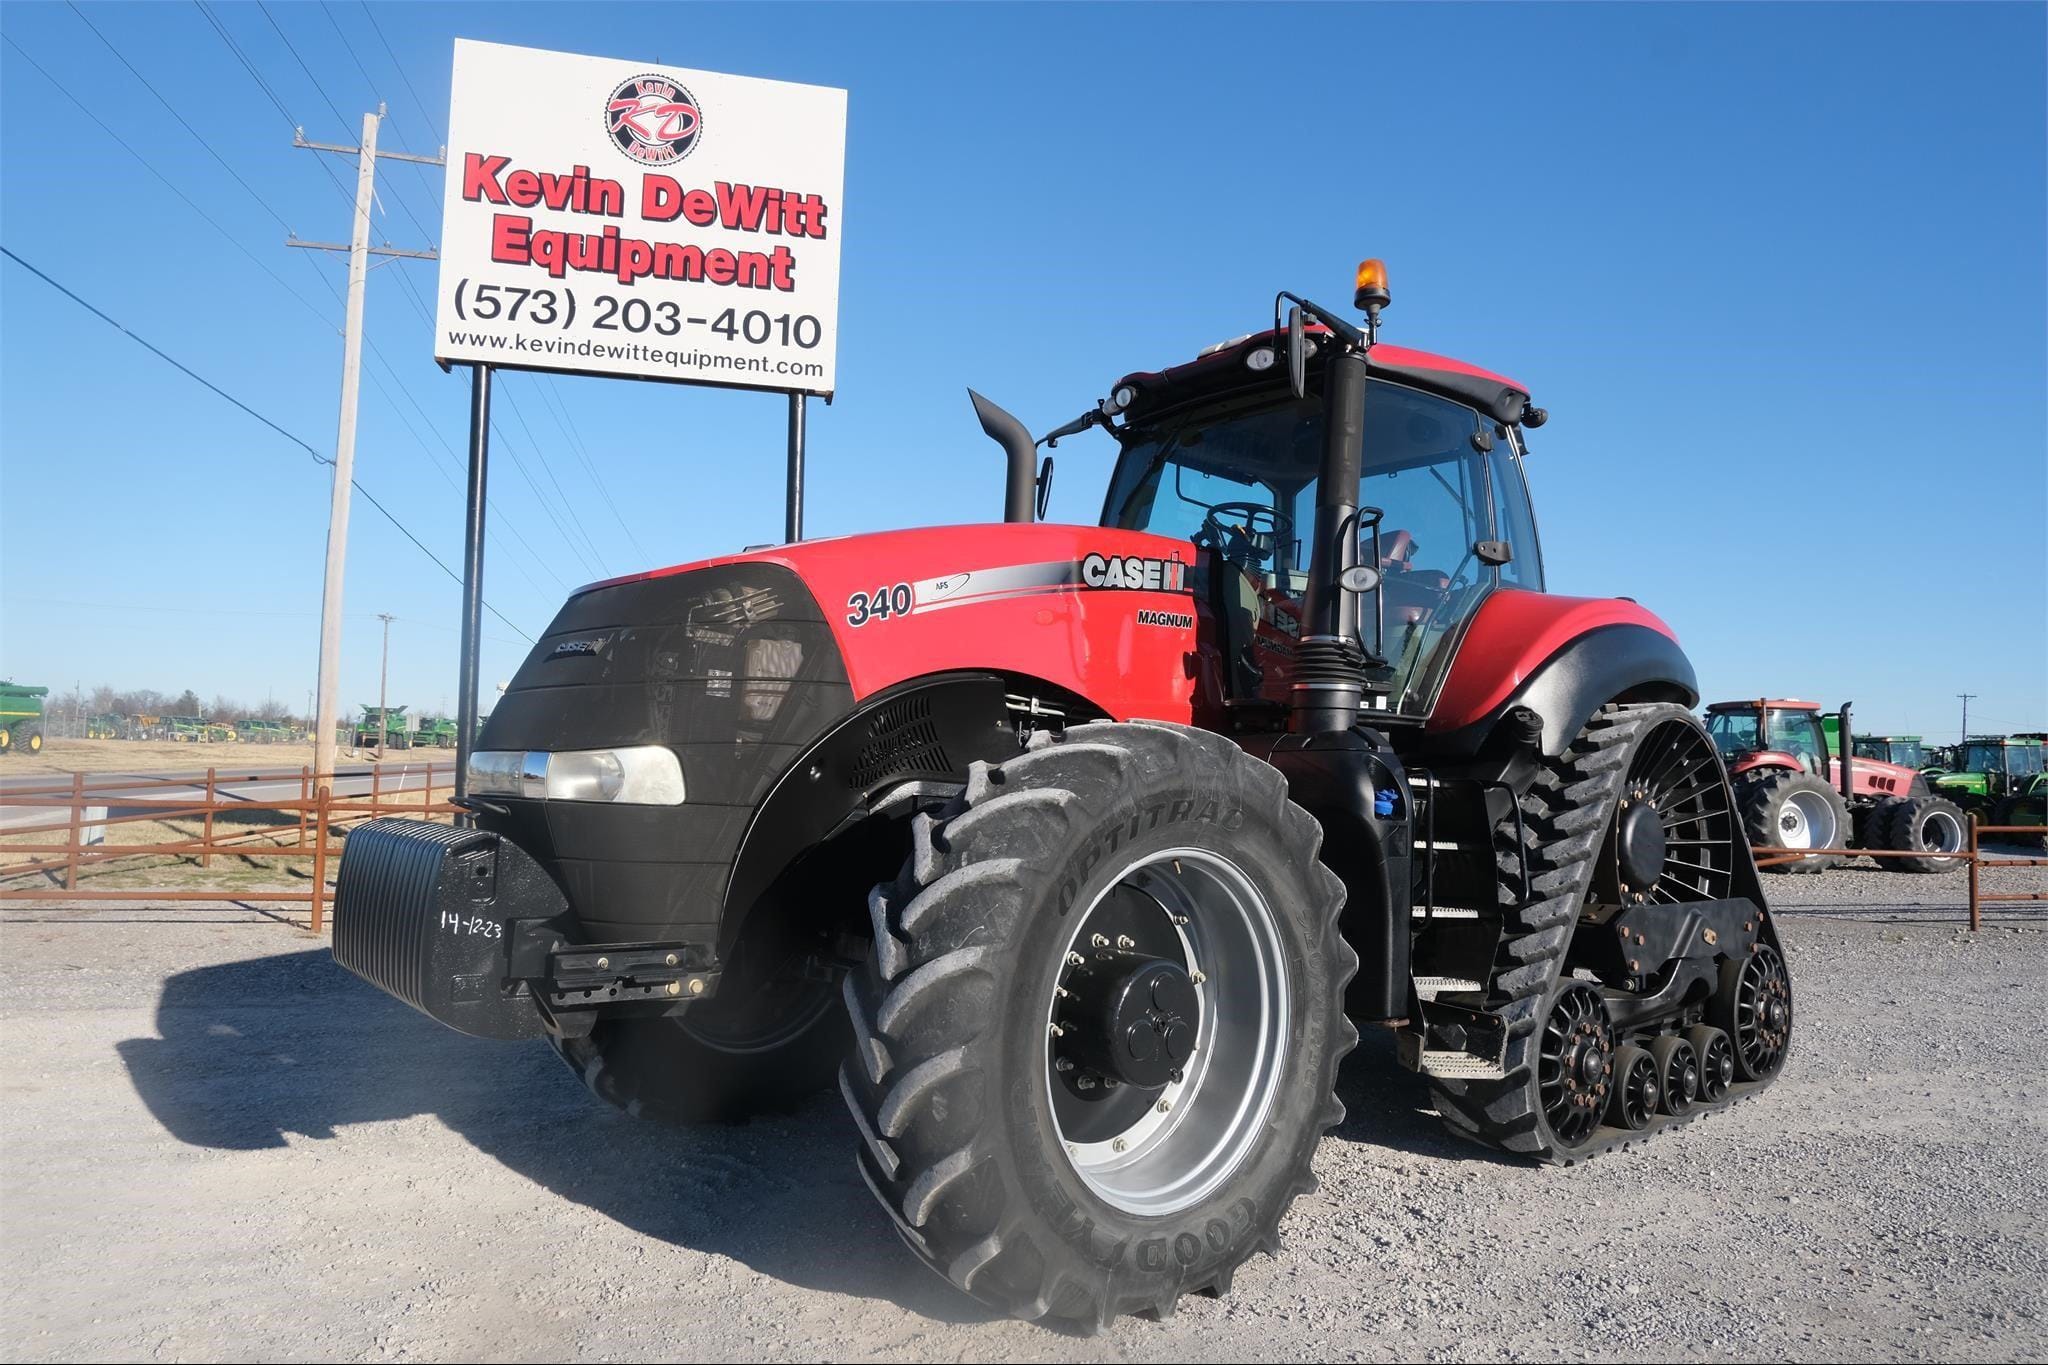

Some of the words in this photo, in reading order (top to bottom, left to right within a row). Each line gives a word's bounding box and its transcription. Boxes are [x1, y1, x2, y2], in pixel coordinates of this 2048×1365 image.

[634, 80, 676, 100] Kevin
[627, 140, 678, 161] DeWitt
[463, 152, 624, 217] Kevin
[641, 173, 828, 239] DeWitt
[491, 213, 796, 292] Equipment
[454, 278, 576, 330] (573)
[592, 296, 822, 350] 203-4010
[448, 331, 824, 377] www.kevindewittequipment.com
[847, 583, 914, 627] 340
[935, 581, 949, 590] AFS
[1137, 610, 1194, 630] MAGNUM
